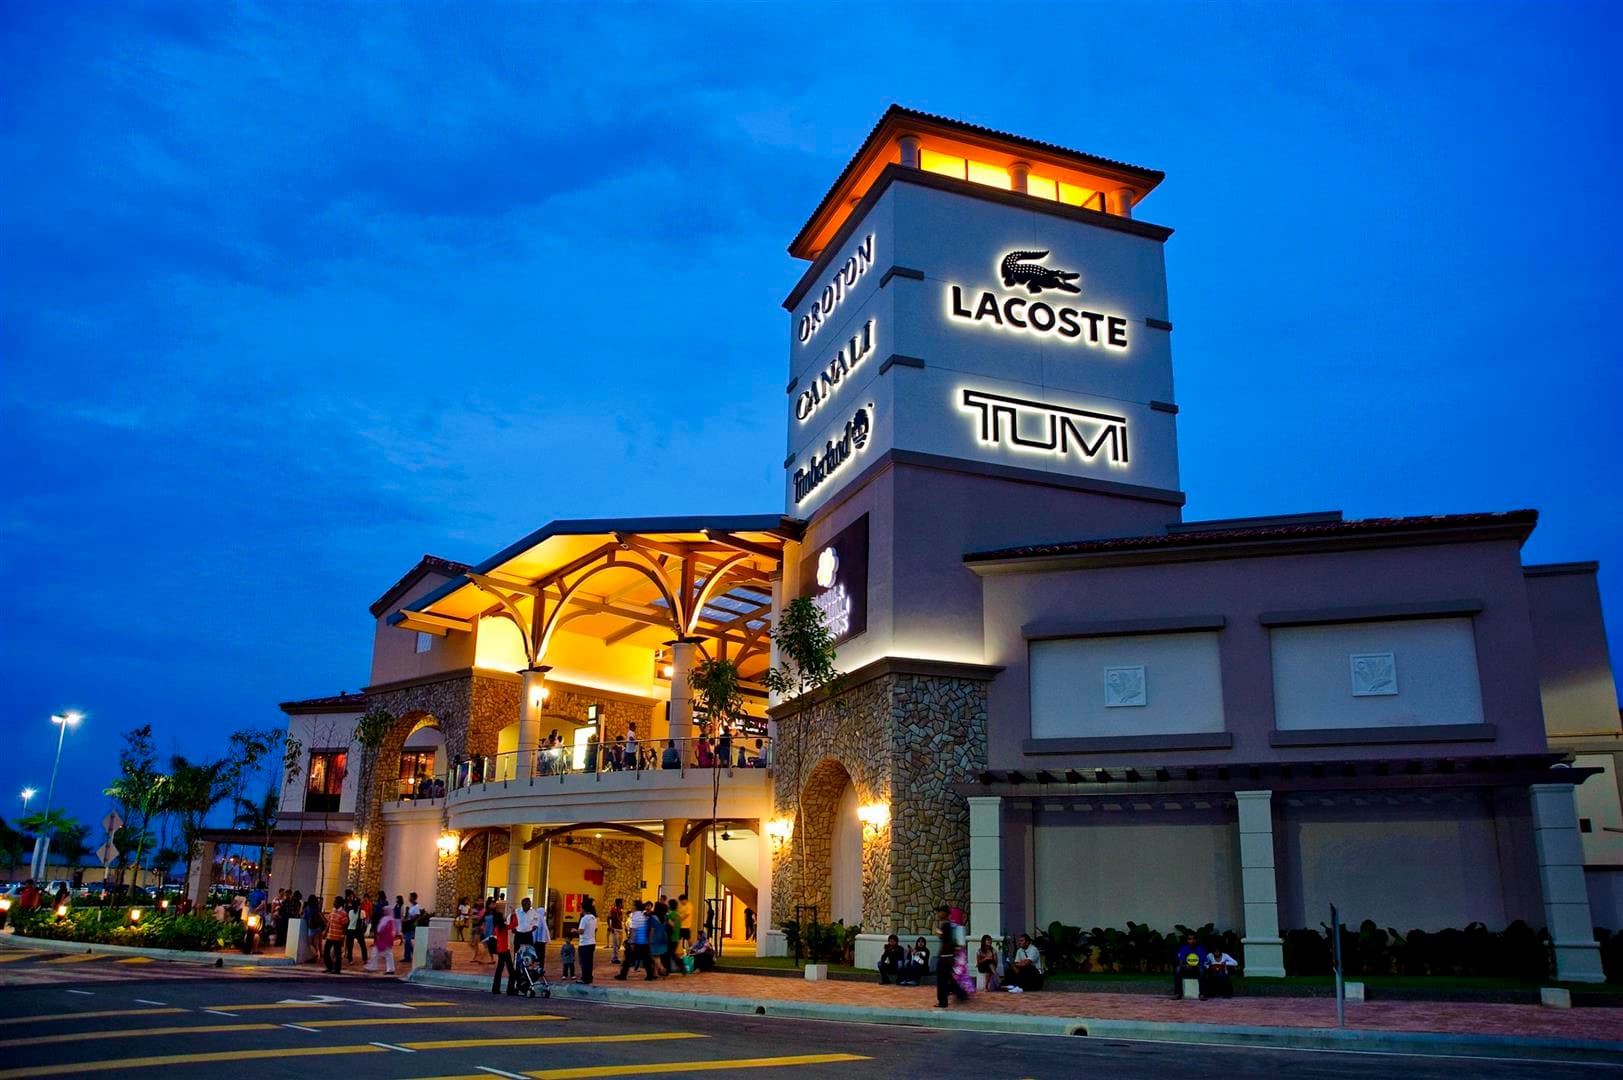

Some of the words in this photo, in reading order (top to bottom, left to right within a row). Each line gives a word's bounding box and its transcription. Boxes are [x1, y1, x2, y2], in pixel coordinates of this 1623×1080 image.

[799, 235, 873, 342] OROTON
[952, 286, 1128, 347] LACOSTE
[796, 320, 873, 420] CANALI
[793, 421, 853, 503] Timberland
[963, 389, 1129, 463] TUMI
